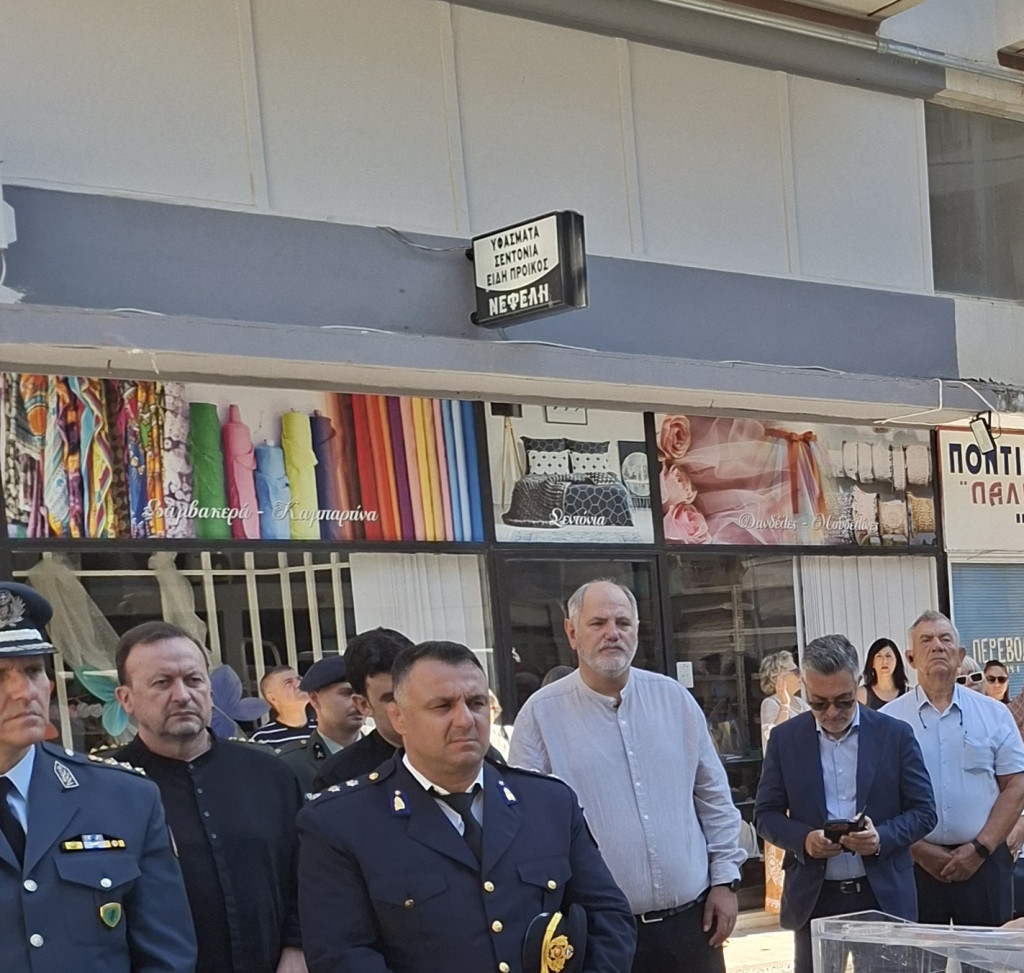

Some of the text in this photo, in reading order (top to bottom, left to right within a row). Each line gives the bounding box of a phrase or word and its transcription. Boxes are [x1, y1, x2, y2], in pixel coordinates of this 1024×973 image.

[490, 226, 540, 252] ΥΦΑΣΜΑΤΑ
[494, 244, 539, 268] ΣΕΝΤΟΝΙΑ
[486, 258, 548, 287] ΕΙΔΗ ΠΡΟΙΚΟΣ
[488, 283, 549, 316] ΝΕΦΕΛΗ
[549, 507, 607, 528] Σεντόνια
